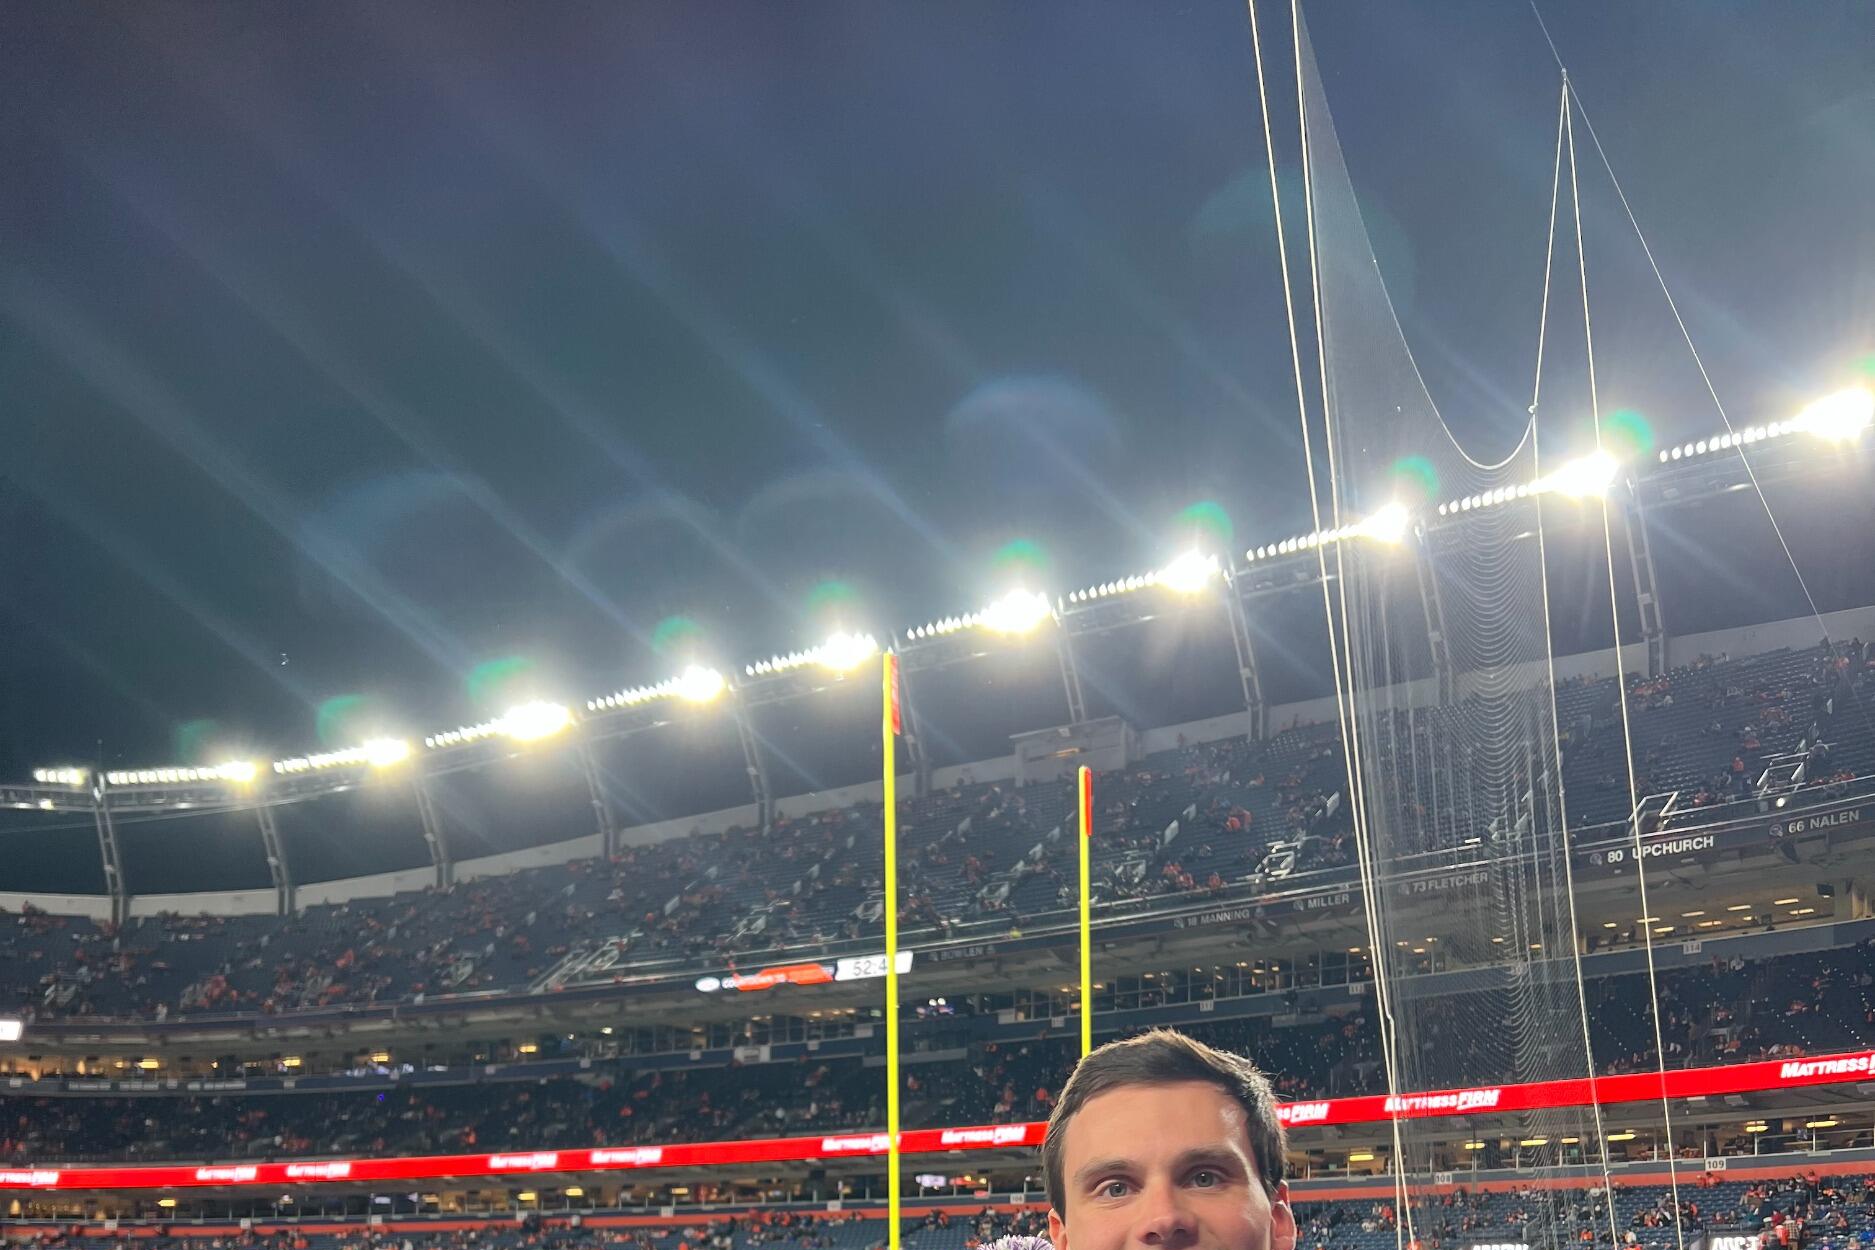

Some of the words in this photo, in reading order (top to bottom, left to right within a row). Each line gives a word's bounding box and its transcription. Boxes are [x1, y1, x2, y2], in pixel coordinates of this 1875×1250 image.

[1788, 820, 1805, 834] 66
[1809, 810, 1860, 829] NALEN
[1607, 849, 1624, 864] 80
[1632, 835, 1714, 860] UPCHURCH
[1413, 881, 1427, 893] 73
[1428, 871, 1488, 890] FLETCHER
[1307, 893, 1350, 909] MILLER
[1200, 908, 1250, 925] MANNING
[852, 958, 888, 977] 52:4
[1780, 1057, 1869, 1079] MATTRESS
[1456, 1089, 1501, 1111] FIRM
[1707, 1160, 1725, 1169] 109
